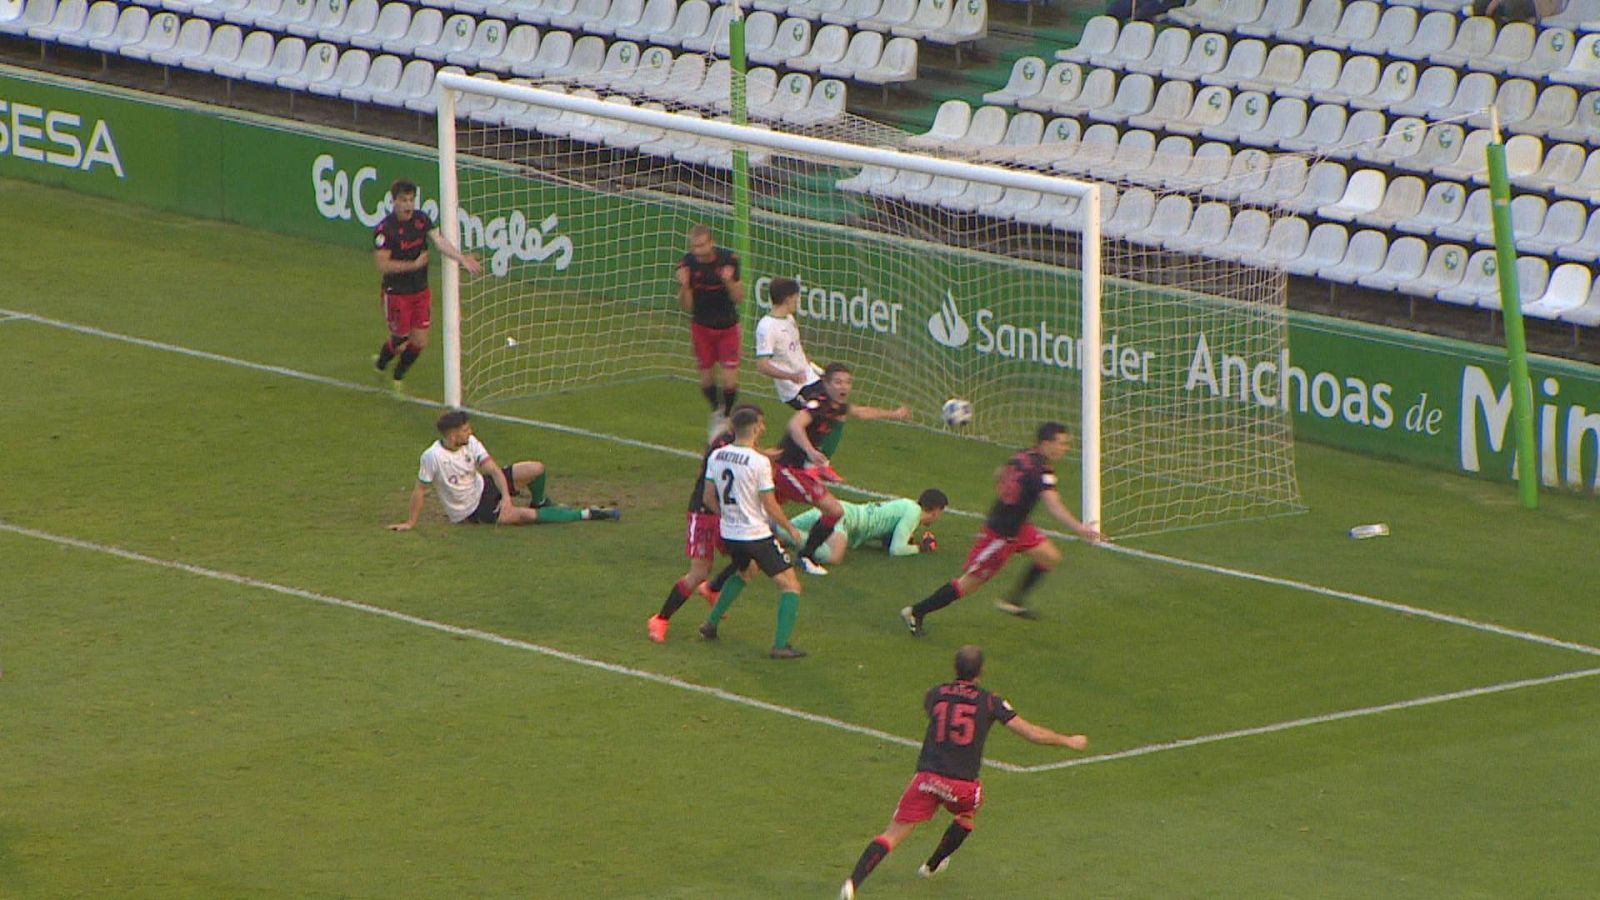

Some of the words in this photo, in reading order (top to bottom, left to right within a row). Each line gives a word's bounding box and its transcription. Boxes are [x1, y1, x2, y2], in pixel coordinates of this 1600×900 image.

[0, 100, 125, 178] ESA
[312, 153, 352, 220] El
[456, 206, 574, 278] nglés
[1184, 331, 1394, 430] Anchoas
[1405, 392, 1443, 436] de
[721, 468, 737, 505] 2
[933, 700, 977, 746] 15
